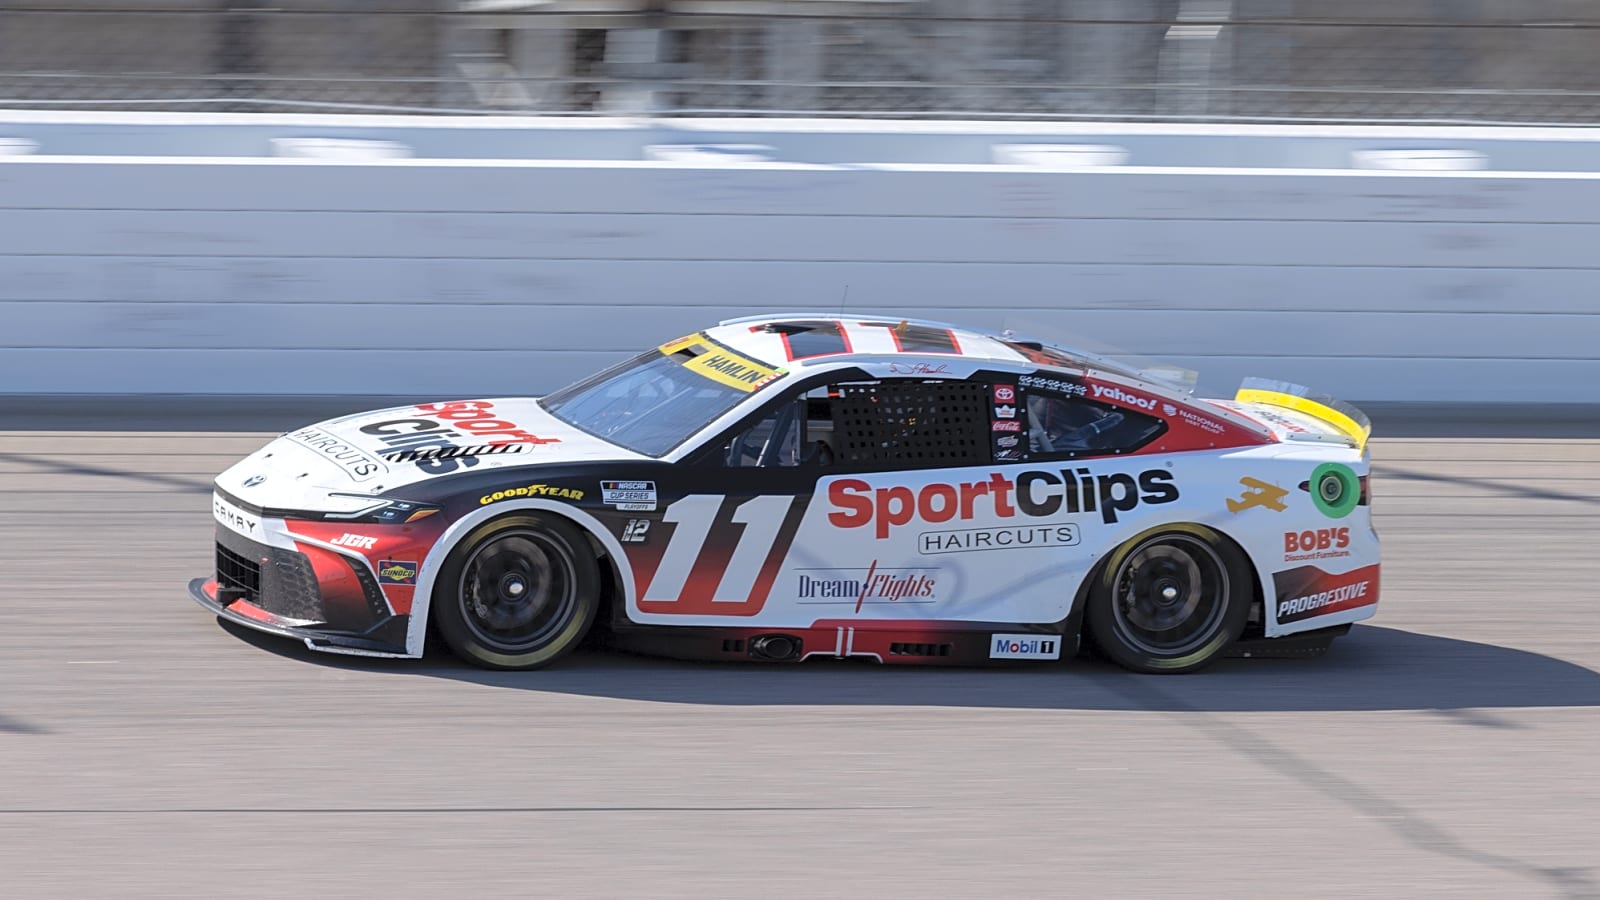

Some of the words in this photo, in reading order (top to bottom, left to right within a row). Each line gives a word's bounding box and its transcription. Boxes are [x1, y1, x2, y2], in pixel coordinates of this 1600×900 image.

[702, 355, 765, 383] HAMLIN
[1091, 384, 1157, 410] yahoo!
[412, 401, 562, 448] Sport
[1179, 410, 1225, 432] NATIONAL
[294, 430, 378, 476] HAIRCUTS
[480, 484, 584, 505] GOODYEAR
[618, 482, 647, 490] NASCAR
[625, 492, 648, 500] SERIES
[214, 502, 257, 533] CAMRY
[330, 533, 378, 549] JGR
[621, 519, 650, 542] 12
[925, 527, 1074, 551] HAIRCUTS
[1284, 527, 1350, 552] BOB'S
[641, 494, 795, 603] 11
[1284, 553, 1316, 561] Discount
[381, 568, 415, 578] SUNOCO
[798, 575, 860, 598] Dream
[867, 574, 935, 601] Flights
[1277, 580, 1371, 617] PROGRESSIVE
[996, 640, 1038, 653] Mobil
